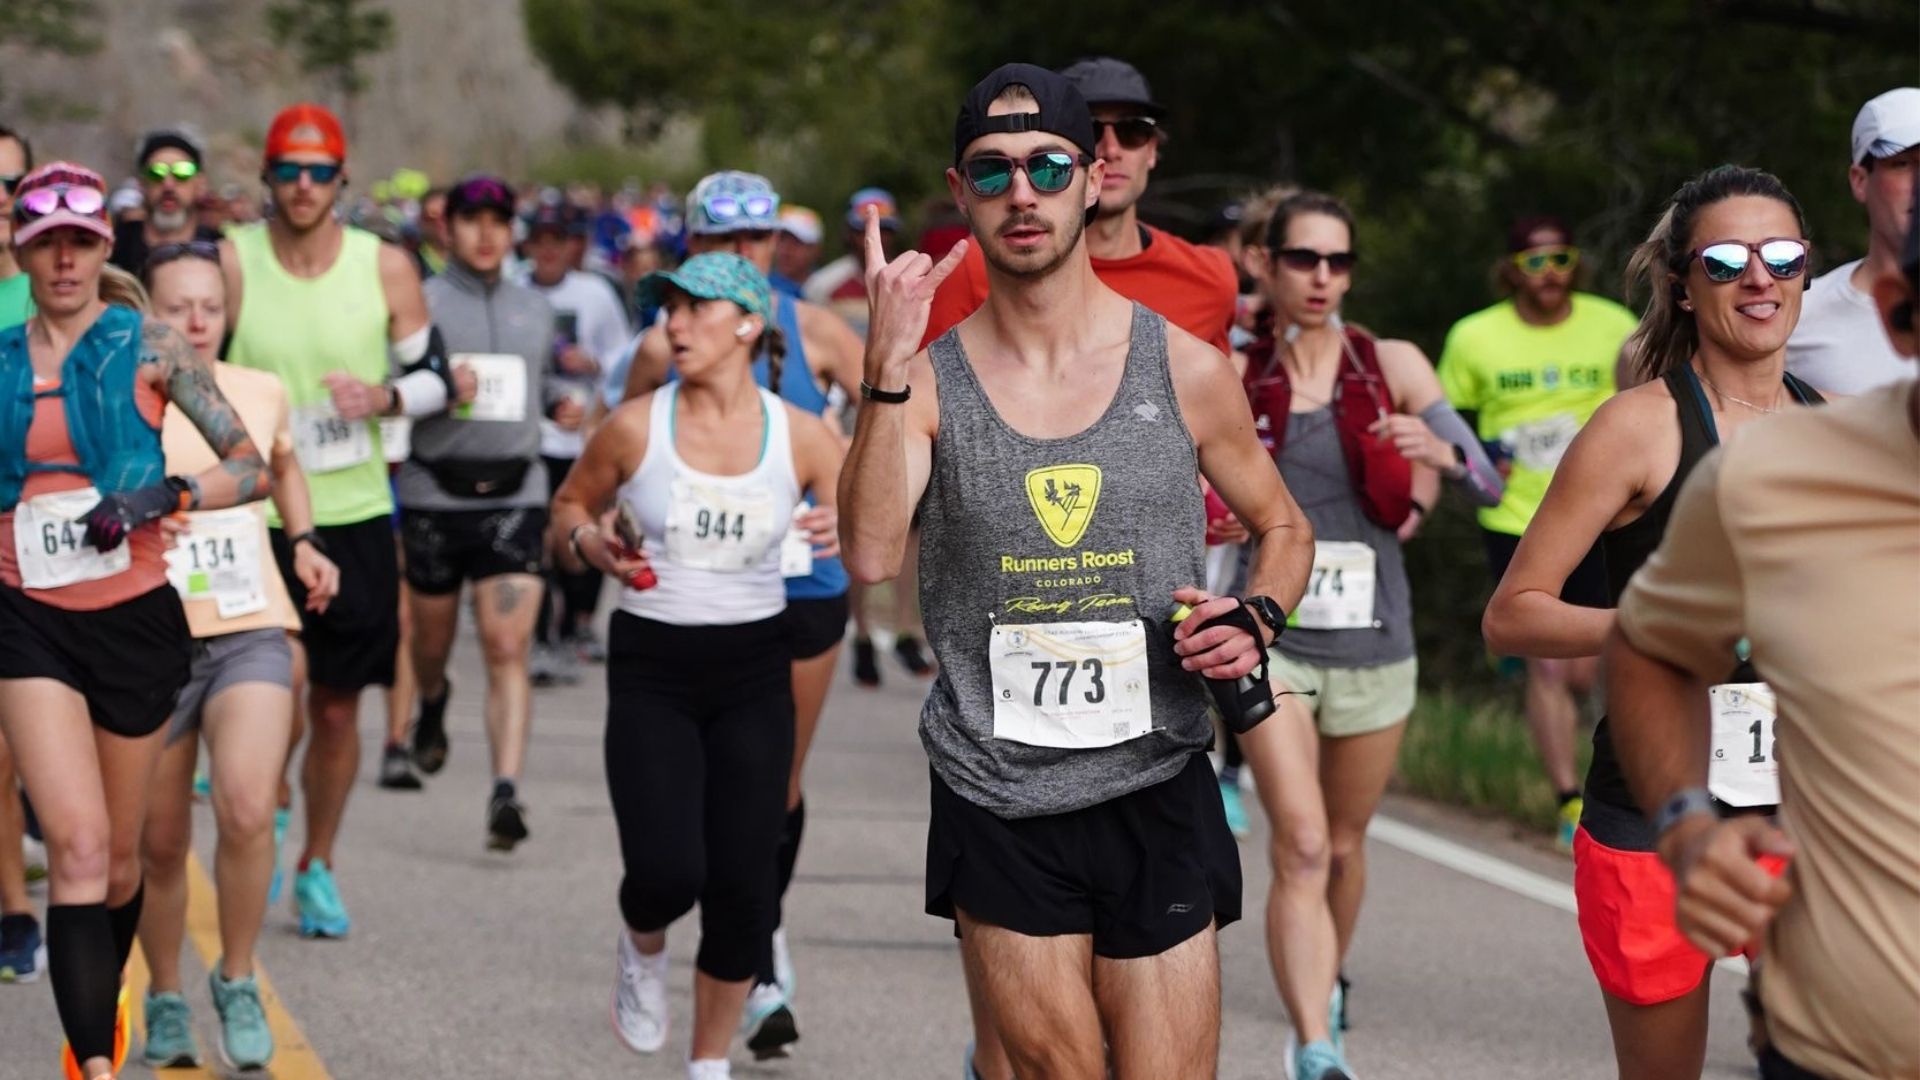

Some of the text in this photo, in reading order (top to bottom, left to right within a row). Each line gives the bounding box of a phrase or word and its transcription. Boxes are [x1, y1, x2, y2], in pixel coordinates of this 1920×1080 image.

[42, 519, 90, 555] 64
[695, 509, 745, 541] 944
[190, 538, 235, 569] 134
[1001, 549, 1135, 573] Runners Roost
[1036, 576, 1101, 588] COLORADO
[1305, 567, 1343, 597] 74
[1002, 689, 1011, 699] G
[1031, 658, 1105, 706] 773
